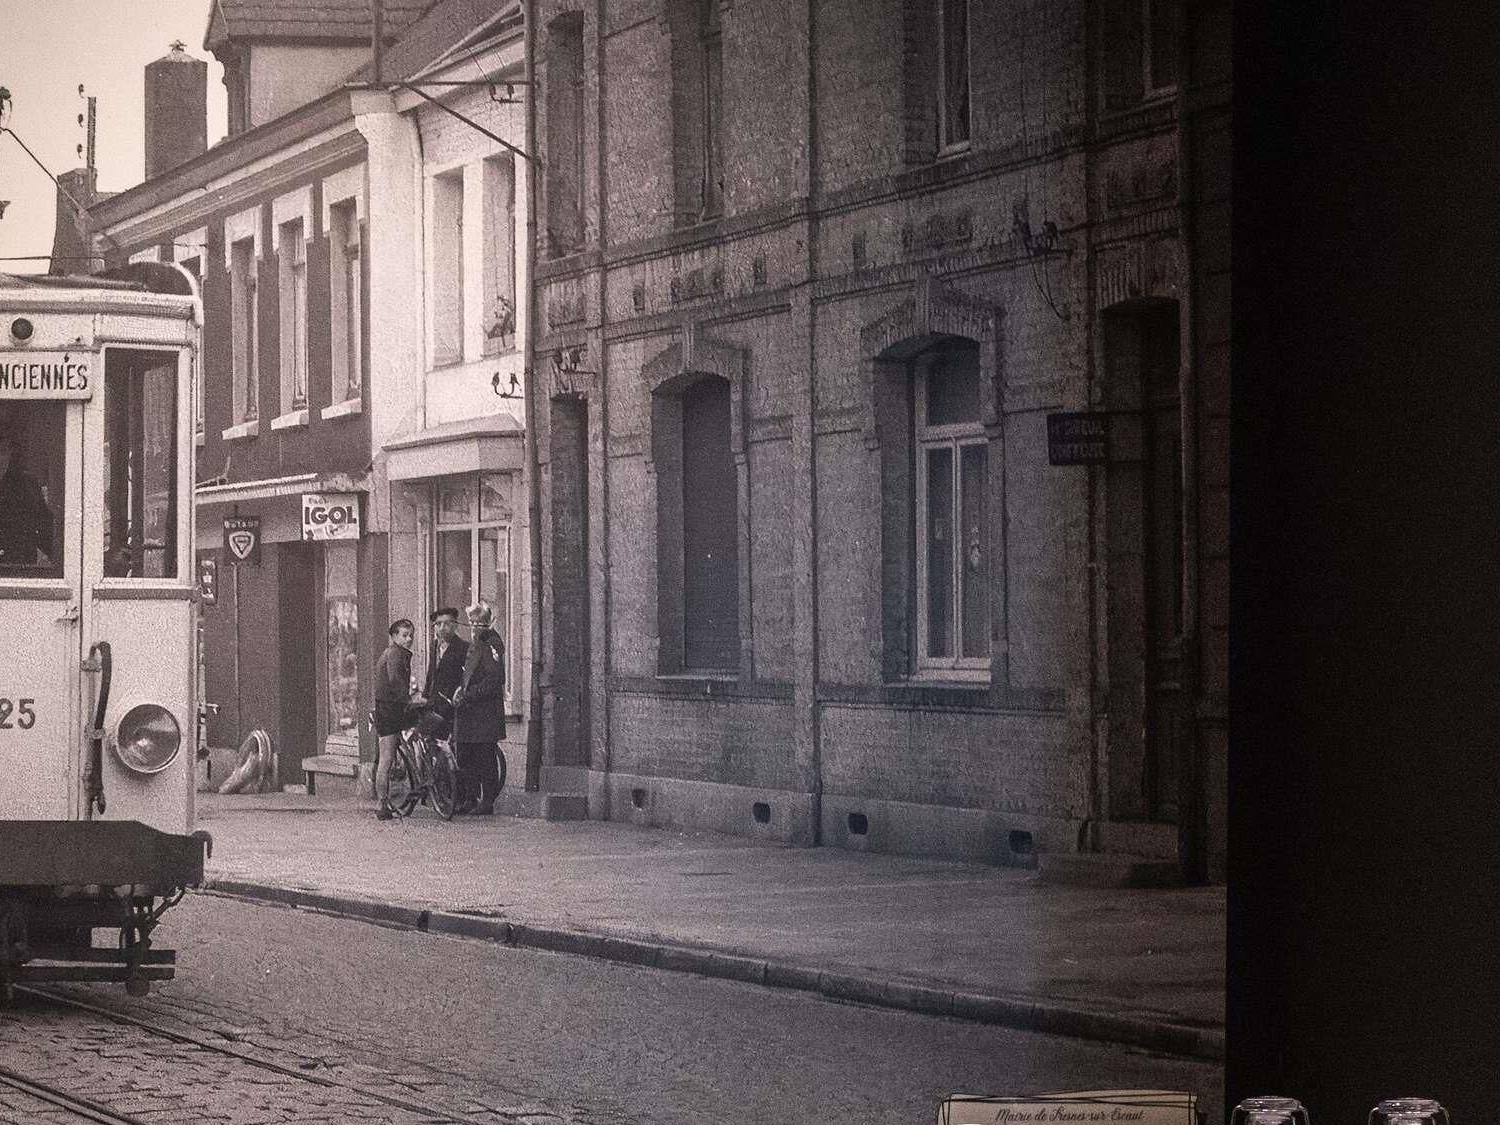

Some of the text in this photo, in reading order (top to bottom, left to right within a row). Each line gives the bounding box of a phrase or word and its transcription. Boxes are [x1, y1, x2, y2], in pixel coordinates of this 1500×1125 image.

[304, 506, 357, 525] IGOL
[995, 1108, 1032, 1125] Mairie
[1034, 1108, 1048, 1121] de
